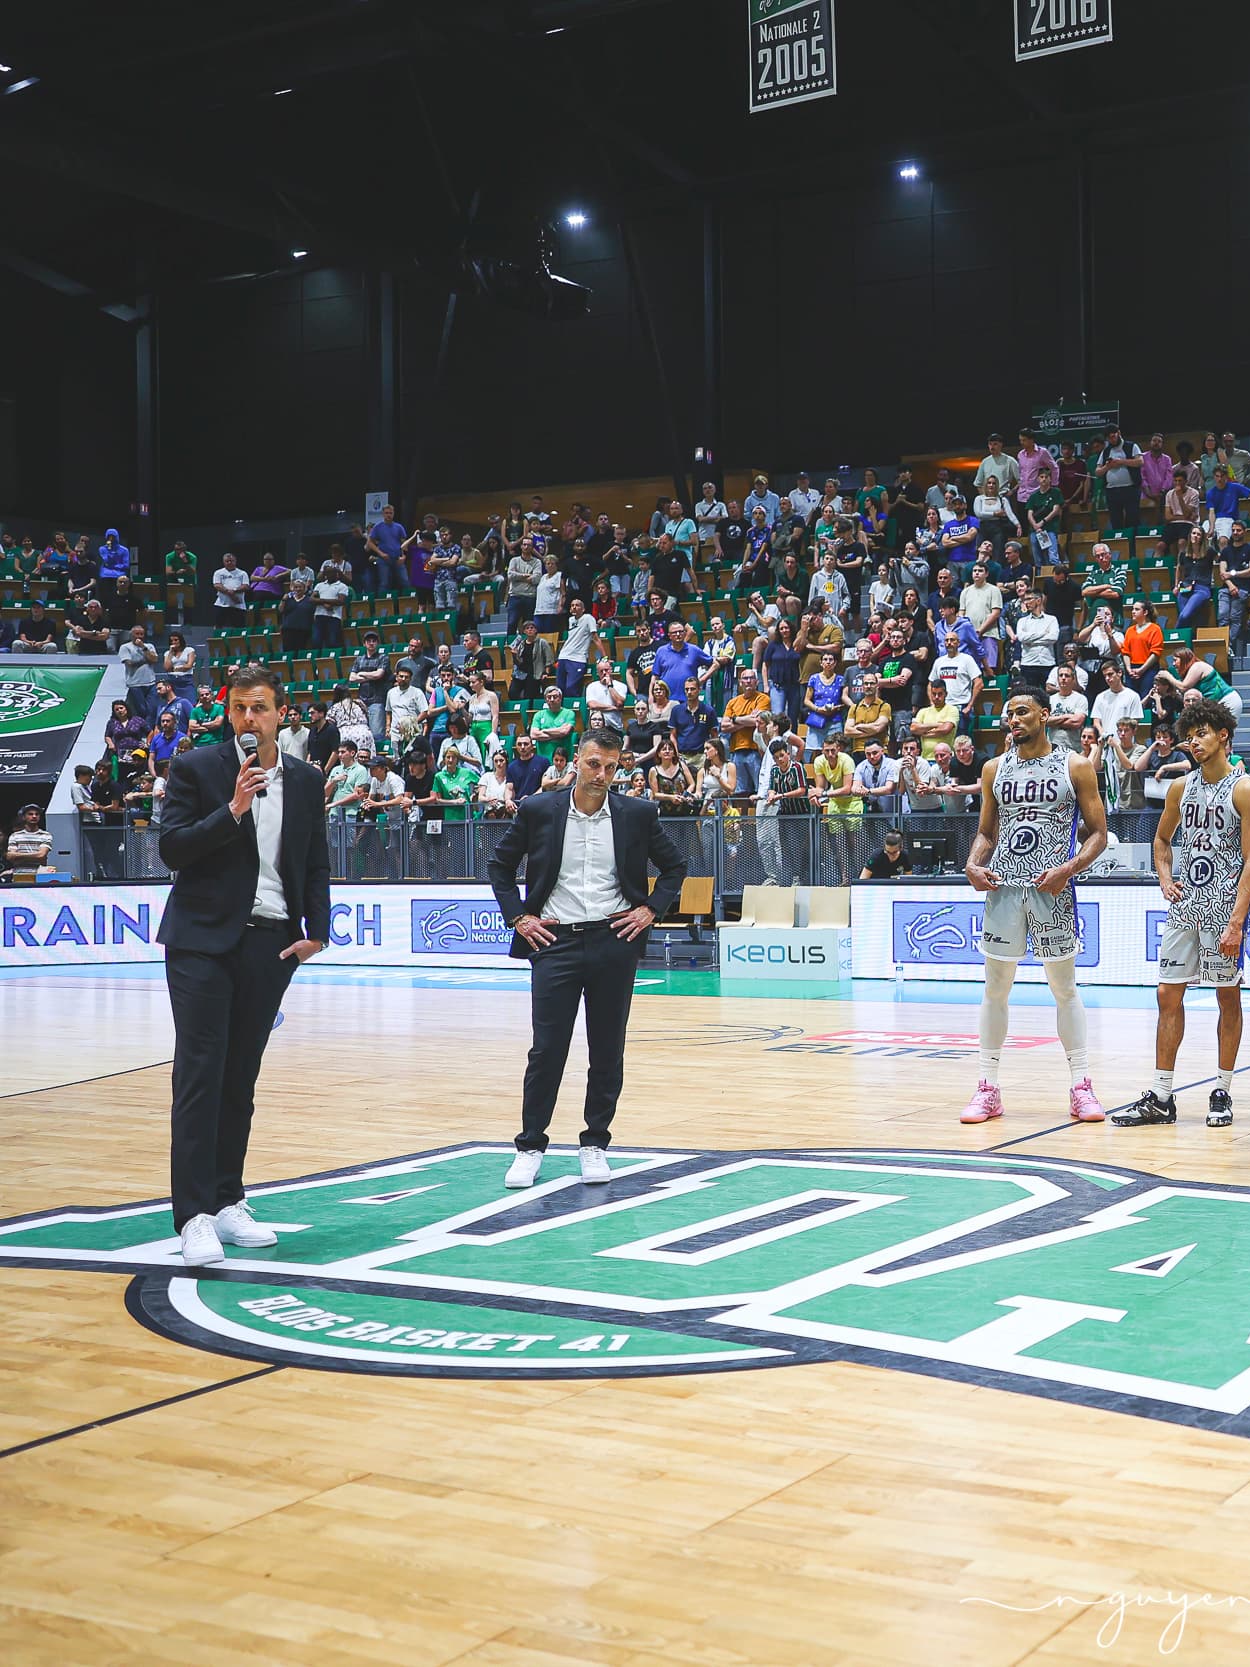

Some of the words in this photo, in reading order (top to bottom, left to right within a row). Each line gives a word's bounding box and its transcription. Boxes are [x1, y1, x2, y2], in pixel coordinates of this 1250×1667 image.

[760, 18, 808, 43] NATIONALE
[813, 10, 821, 30] 2
[758, 34, 826, 89] 2005
[1017, 807, 1038, 822] 35
[1193, 832, 1213, 852] 43
[471, 932, 497, 943] Notre
[763, 1043, 980, 1059] ELITE
[238, 1295, 354, 1331] BLOIS
[325, 1321, 556, 1352] BASKET
[557, 1333, 631, 1352] 41
